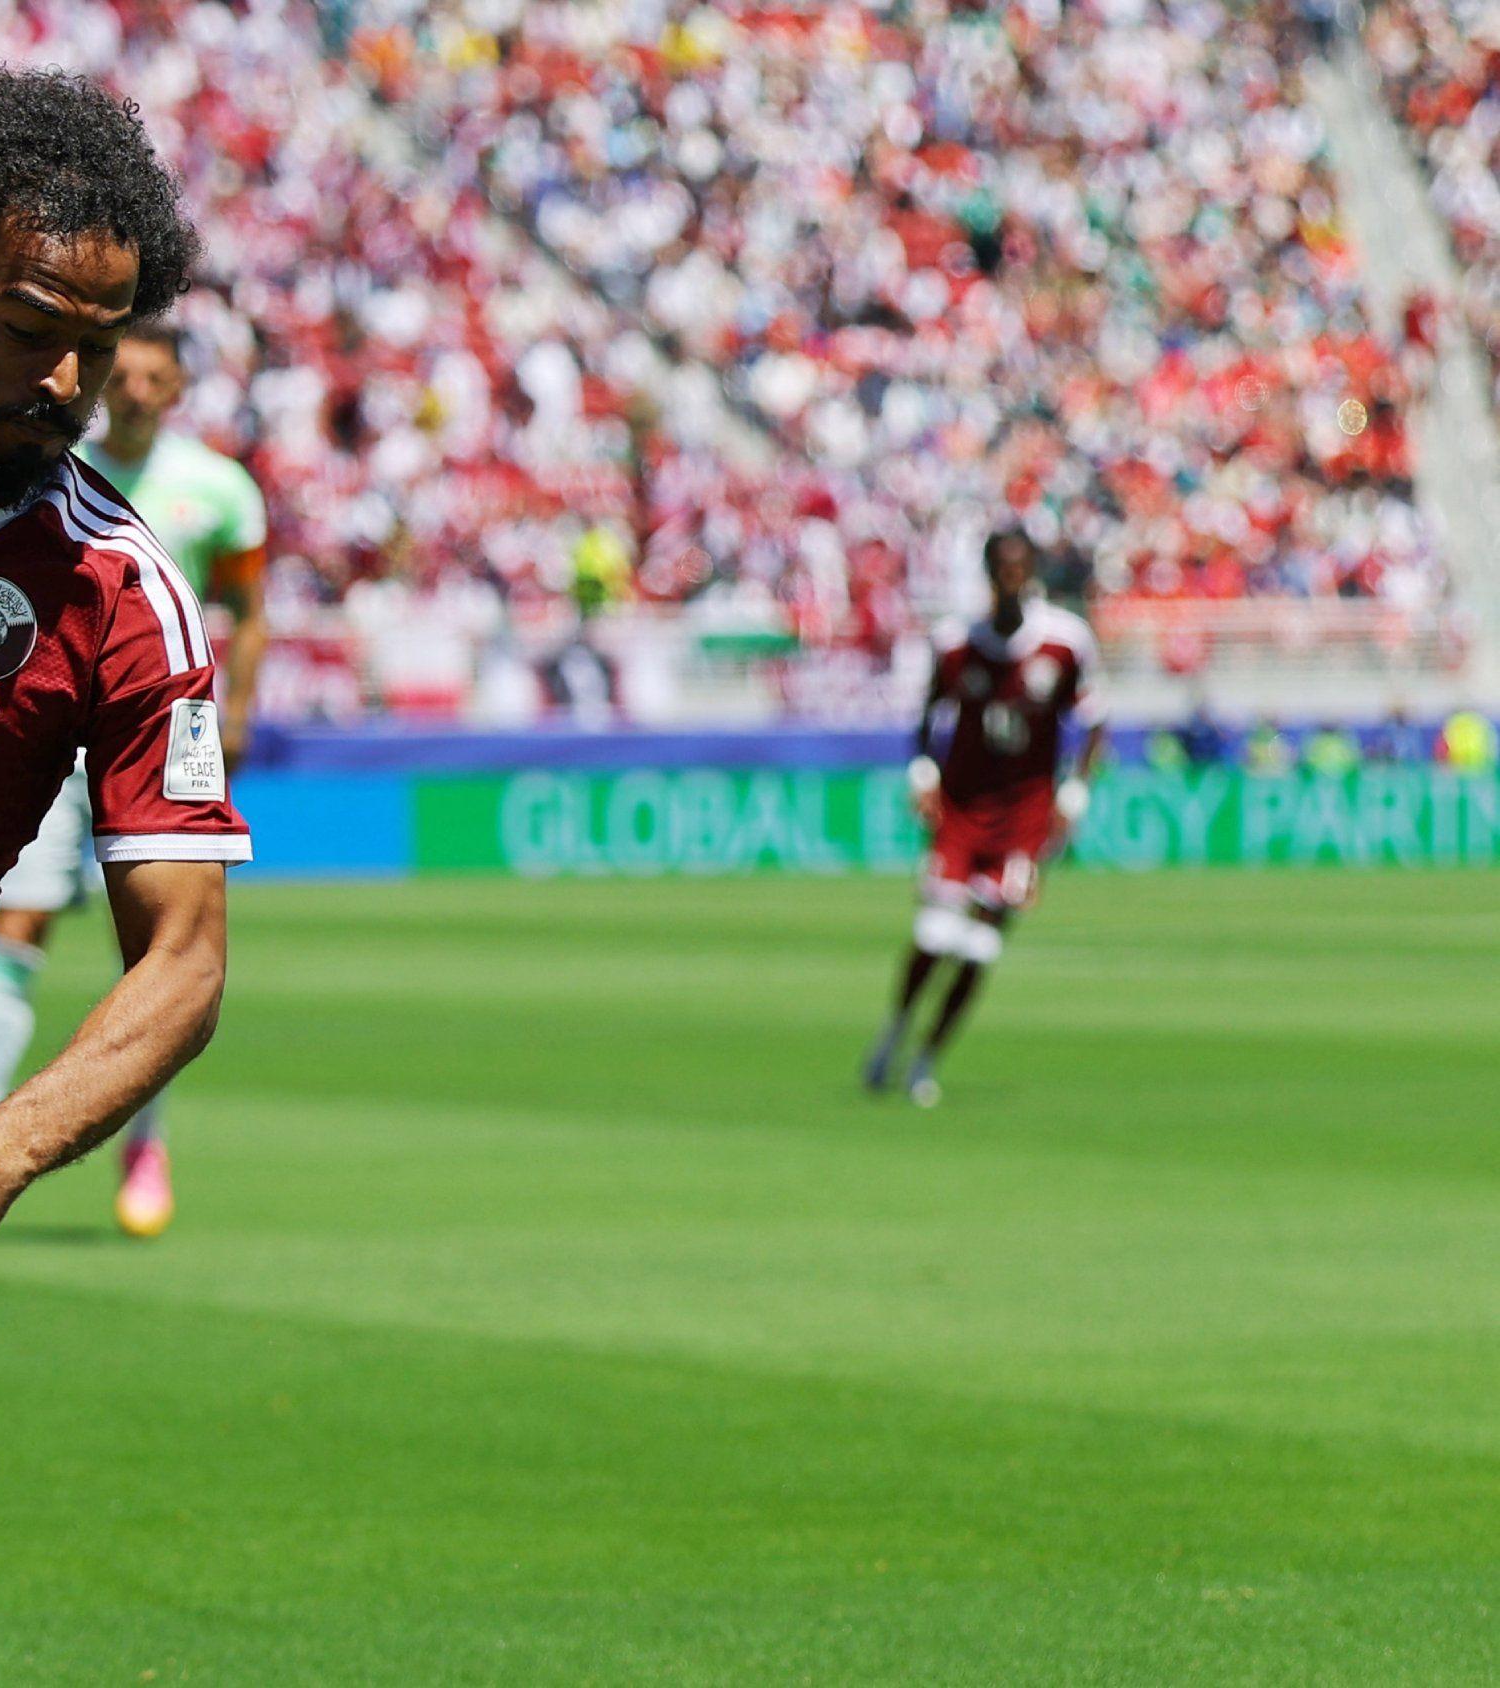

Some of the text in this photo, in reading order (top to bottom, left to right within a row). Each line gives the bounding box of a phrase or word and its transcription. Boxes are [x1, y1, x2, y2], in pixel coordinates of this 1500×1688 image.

[183, 761, 217, 778] PEACE
[191, 780, 210, 788] FIFA
[500, 768, 853, 878] GLOBAL
